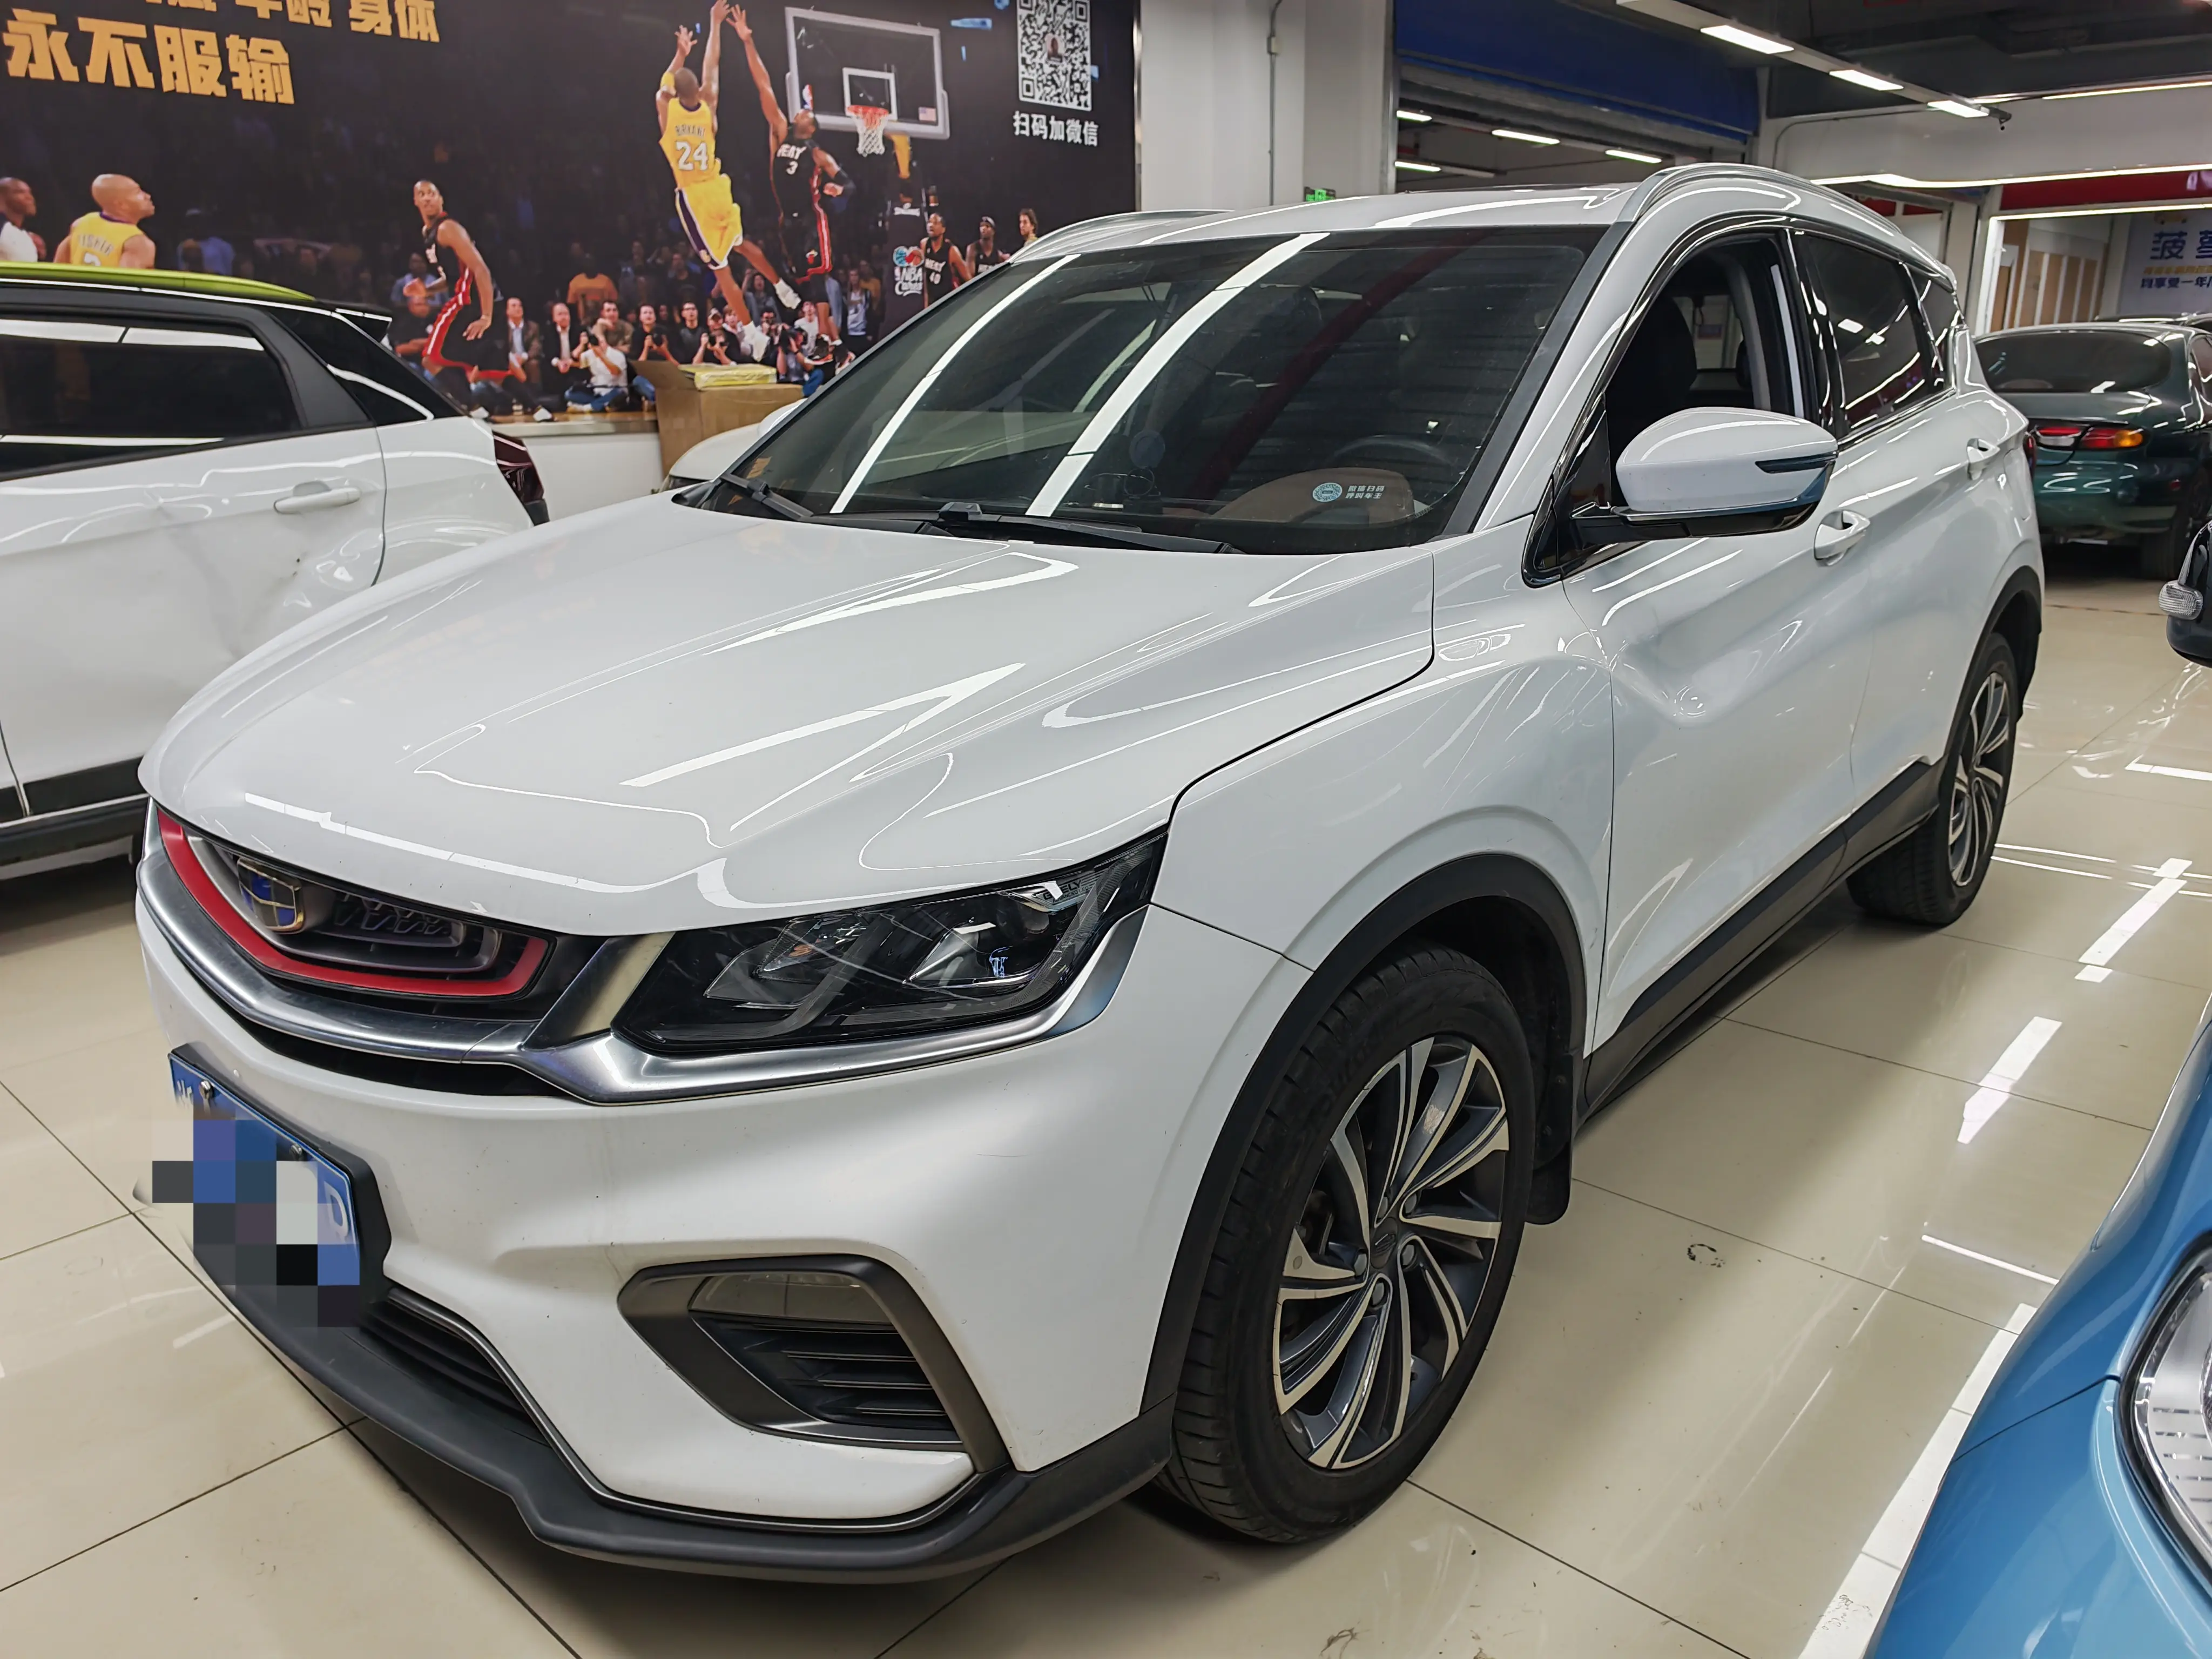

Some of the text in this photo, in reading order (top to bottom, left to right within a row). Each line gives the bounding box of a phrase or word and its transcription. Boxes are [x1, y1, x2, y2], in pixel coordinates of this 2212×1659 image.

[3, 9, 295, 104] 永不服输
[1013, 110, 1098, 147] 扫码加微信
[676, 140, 709, 171] 24
[786, 160, 798, 175] 3
[1043, 879, 1082, 900] GELY
